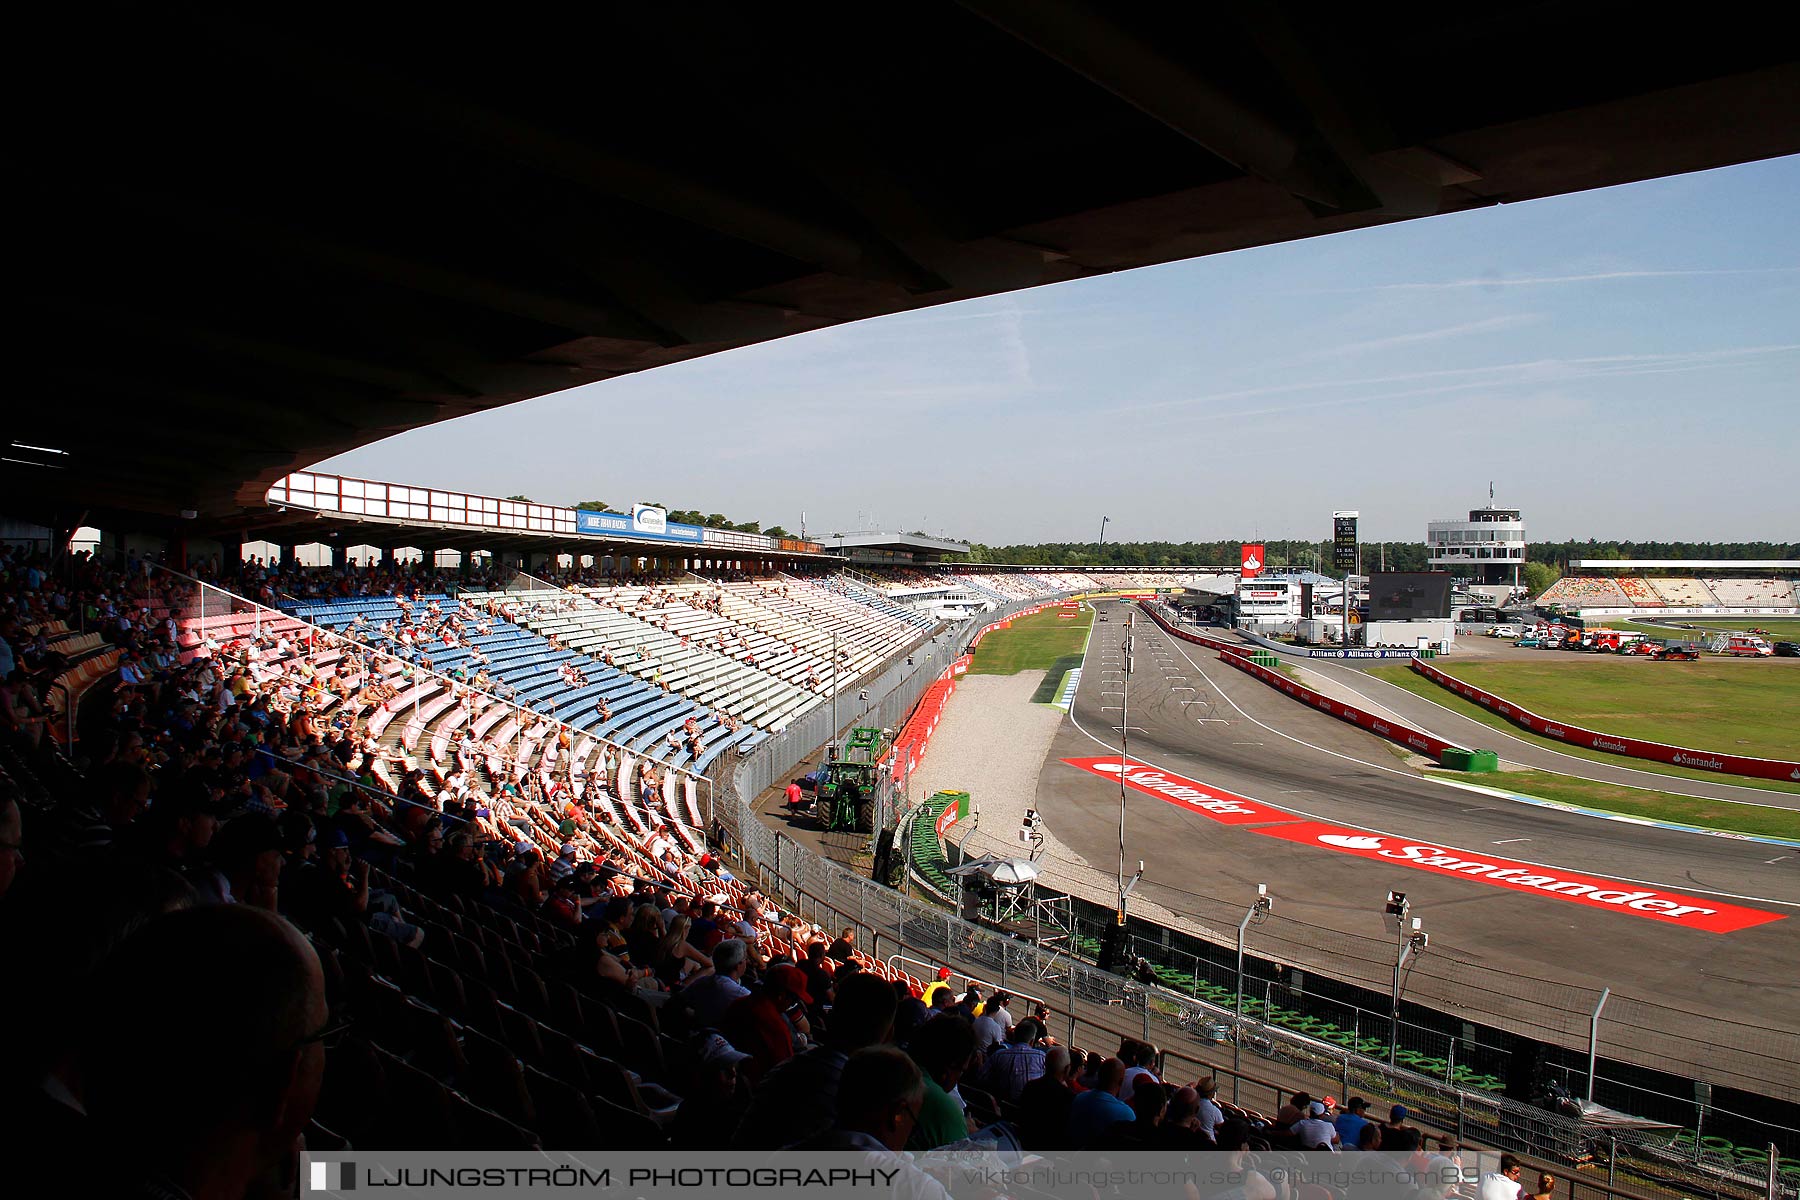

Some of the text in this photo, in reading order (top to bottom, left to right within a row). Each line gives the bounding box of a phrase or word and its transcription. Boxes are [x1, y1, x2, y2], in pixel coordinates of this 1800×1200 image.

[1598, 738, 1626, 753] Santander
[1682, 753, 1723, 770] Santander
[1116, 772, 1256, 815] Santander
[1378, 845, 1717, 919] Santander
